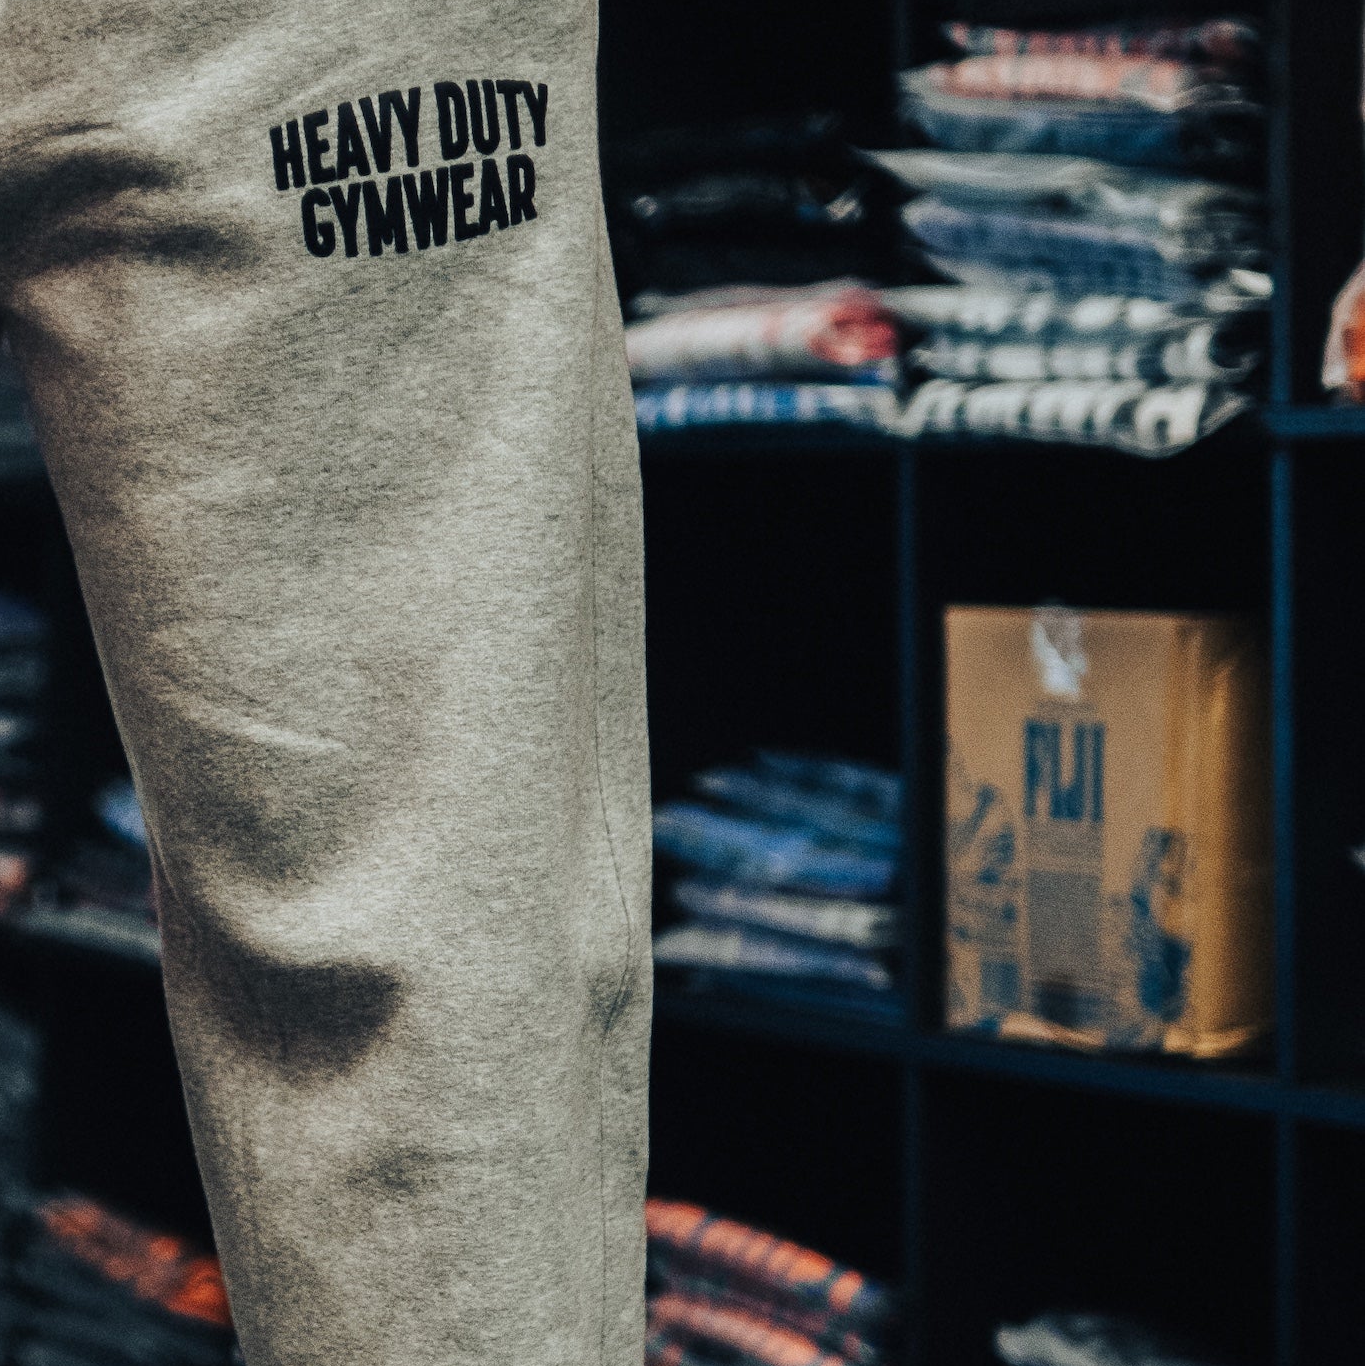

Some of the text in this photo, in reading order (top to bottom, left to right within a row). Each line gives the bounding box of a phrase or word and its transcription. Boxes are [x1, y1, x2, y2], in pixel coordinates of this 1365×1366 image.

[270, 79, 548, 190] HEAVY DUTY
[301, 154, 538, 258] GYMWEAR
